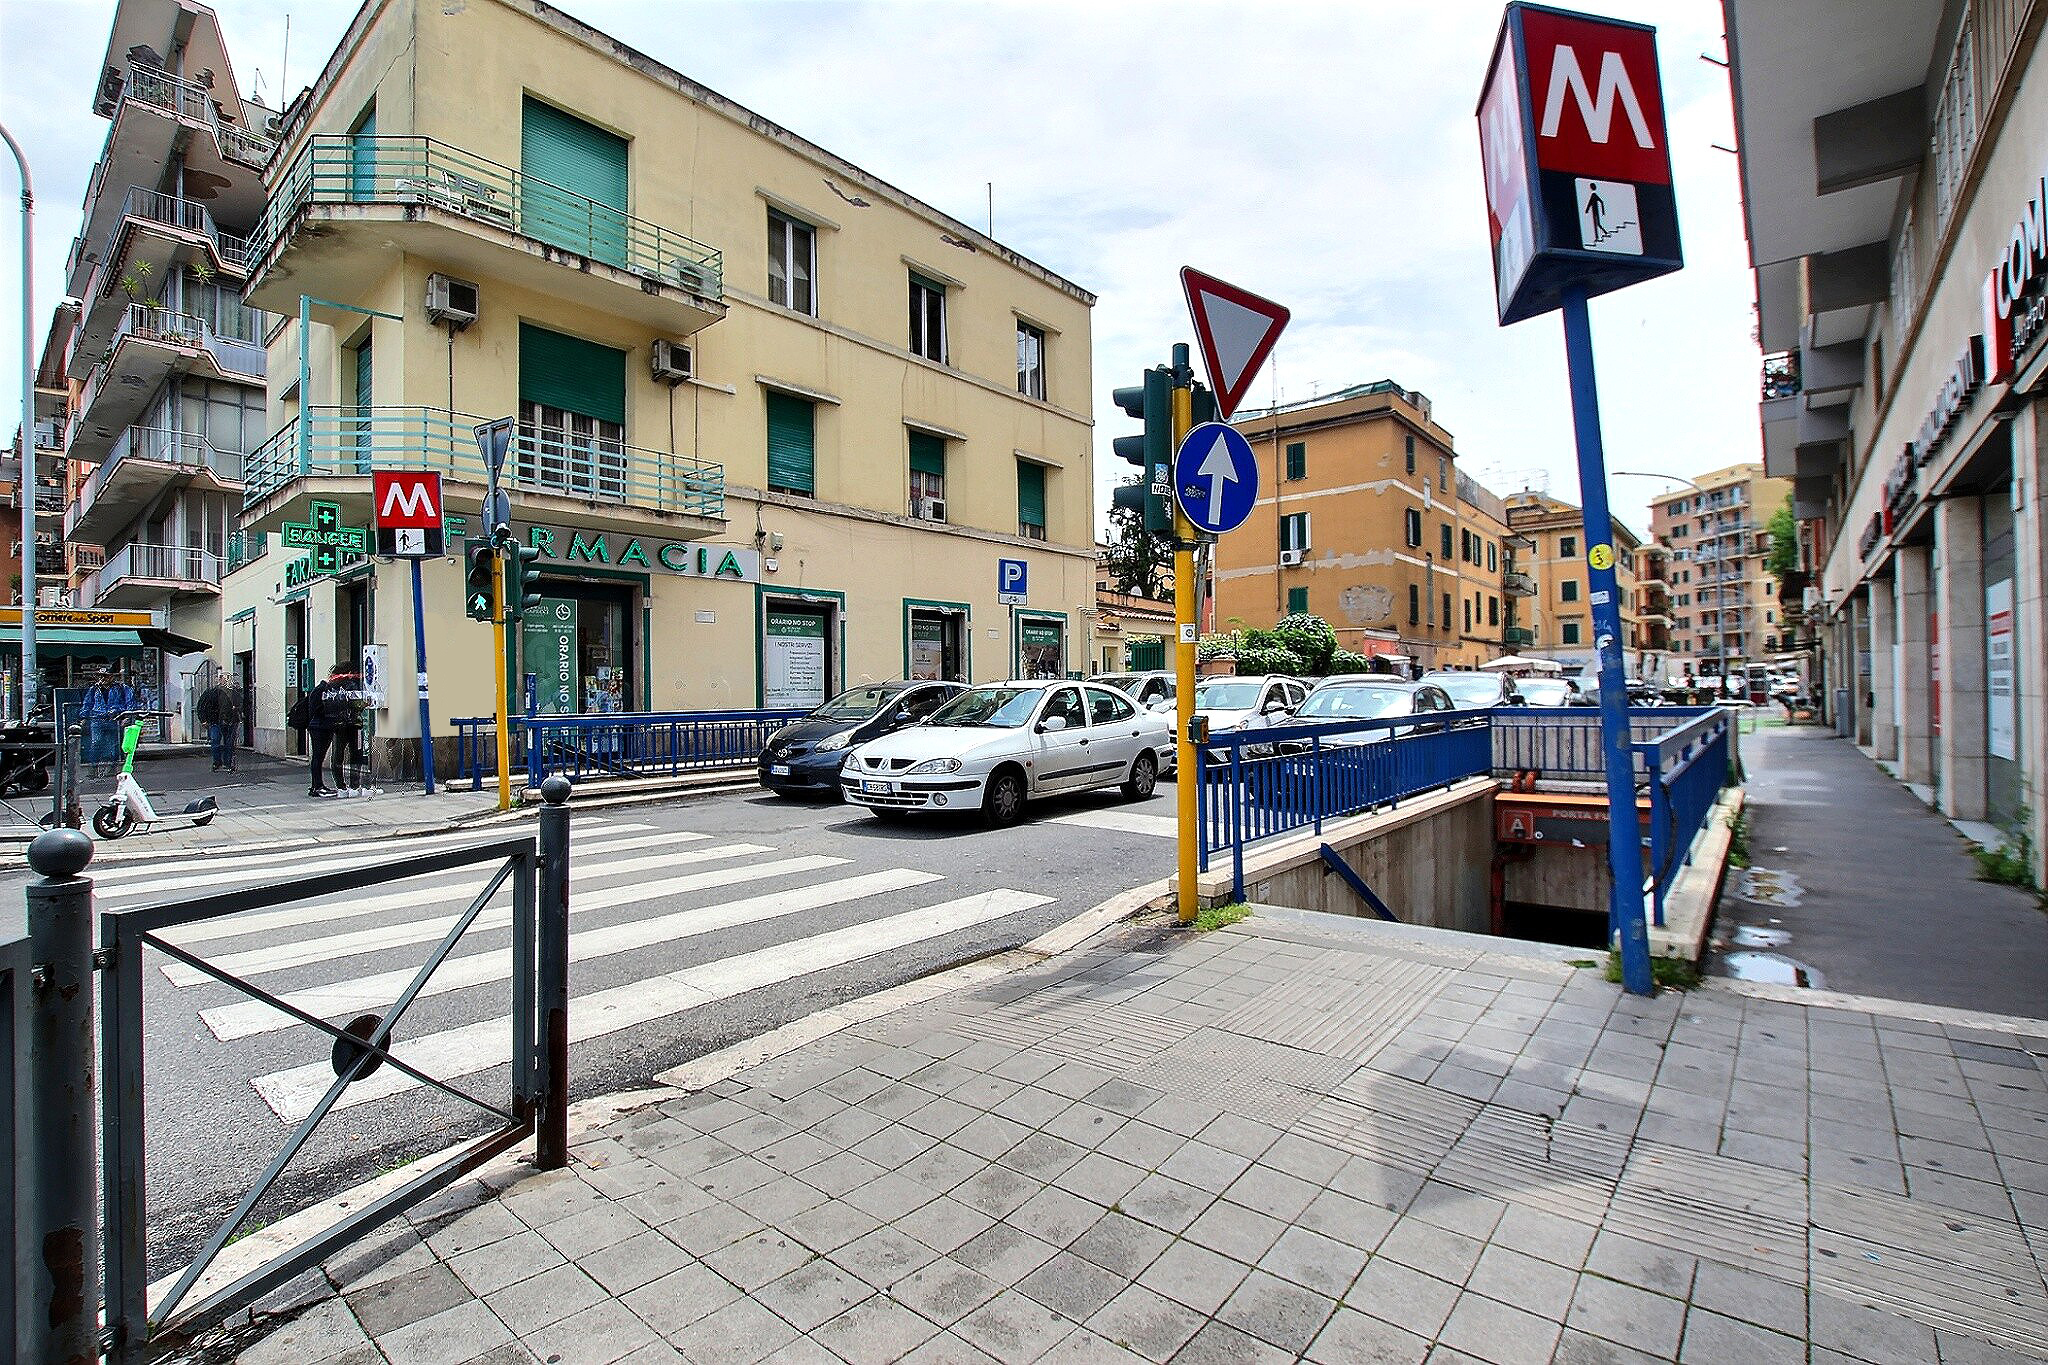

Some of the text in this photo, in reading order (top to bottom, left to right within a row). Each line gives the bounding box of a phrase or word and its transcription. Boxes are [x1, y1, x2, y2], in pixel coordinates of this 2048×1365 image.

[1541, 44, 1655, 149] M
[381, 482, 436, 517] M
[446, 516, 744, 578] FRMACIA
[1005, 563, 1022, 590] P
[86, 613, 114, 624] Sport
[771, 618, 793, 626] ORARIO
[559, 635, 570, 682] ORARIO
[559, 684, 570, 703] NO
